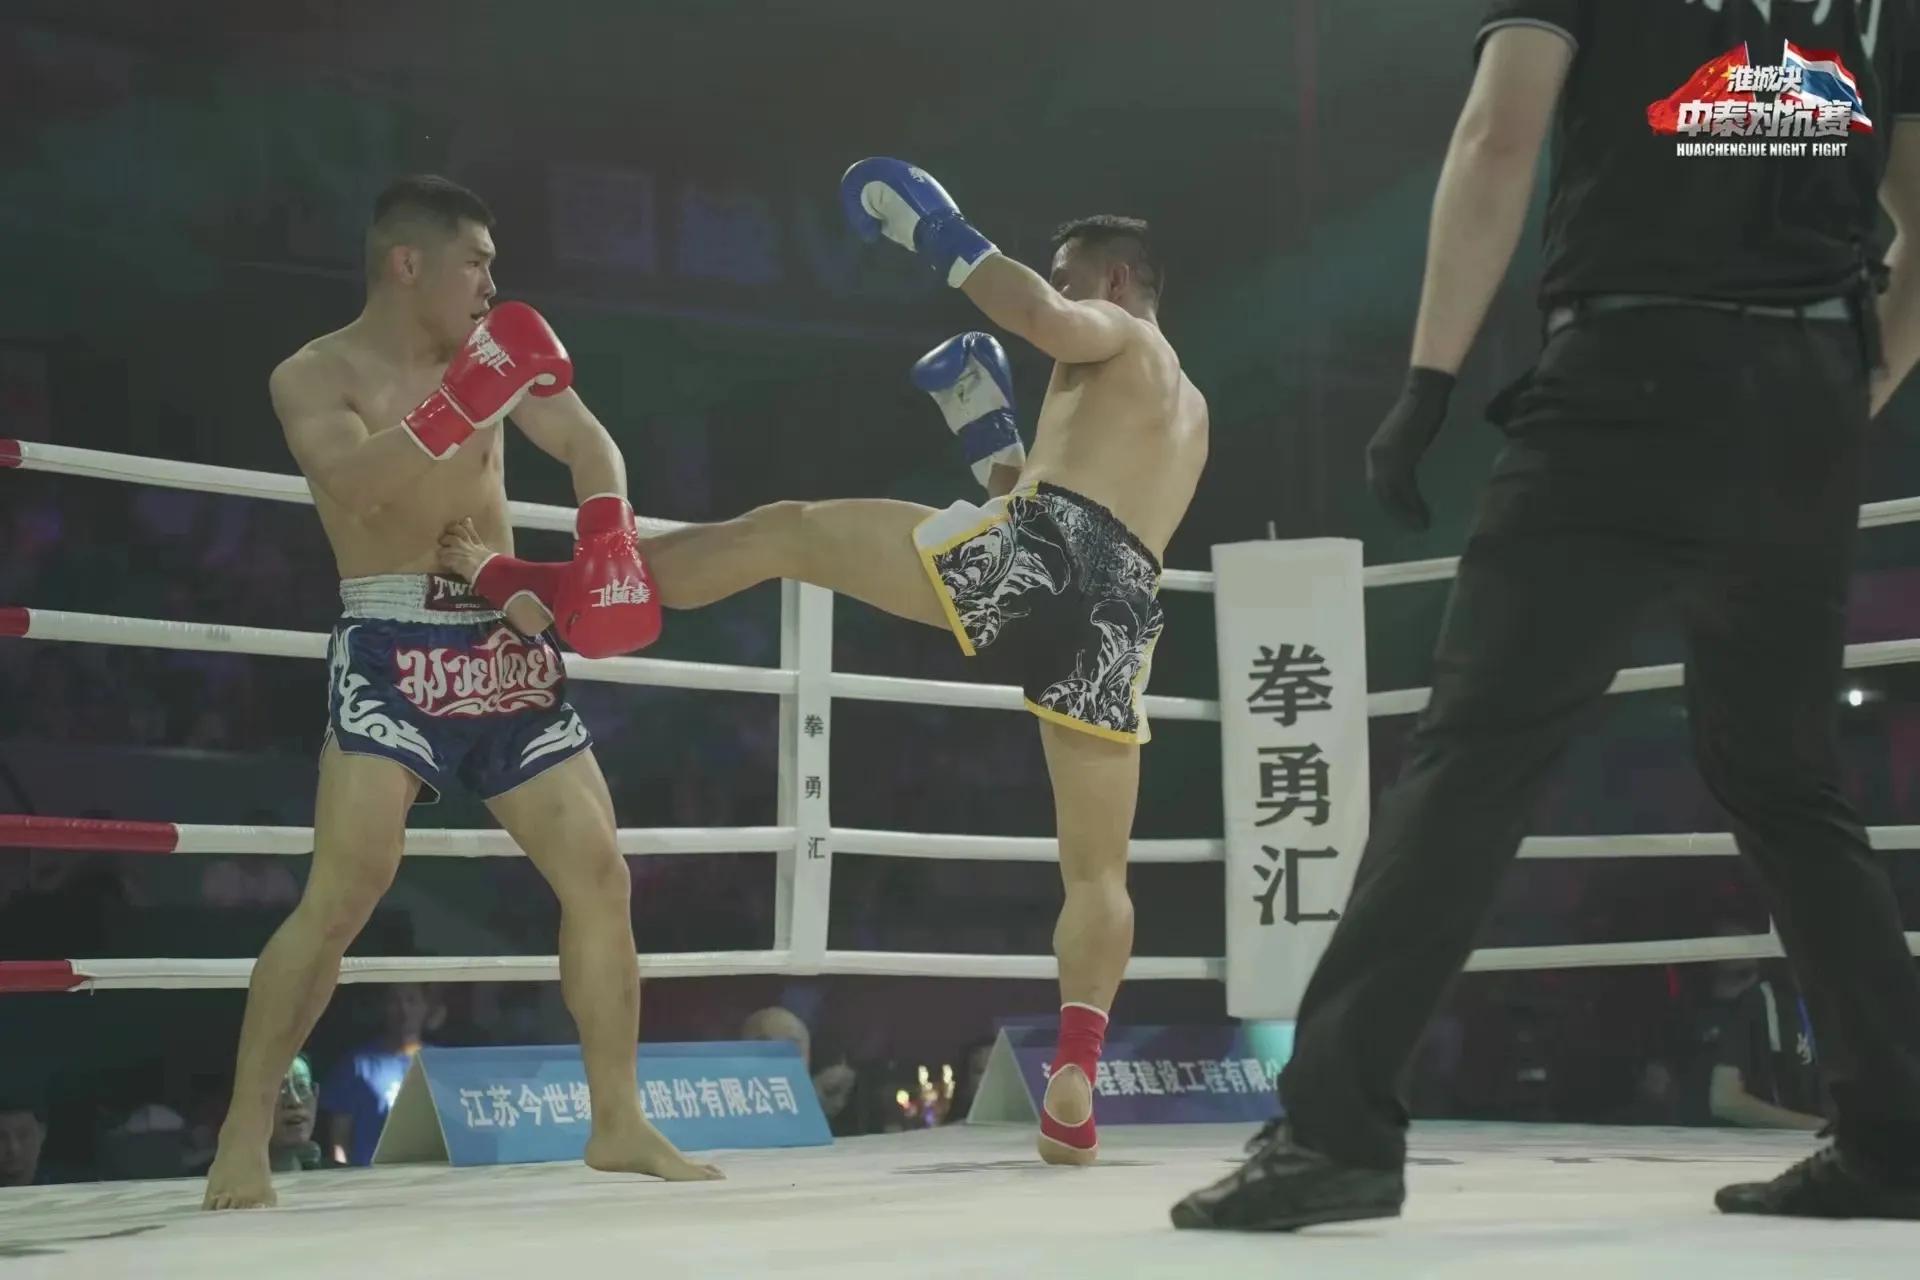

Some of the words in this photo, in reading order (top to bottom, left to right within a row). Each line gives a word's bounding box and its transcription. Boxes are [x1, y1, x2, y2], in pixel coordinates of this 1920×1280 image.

[804, 713, 826, 859] 拳勇汇
[1246, 643, 1341, 925] 拳勇汇
[460, 1076, 799, 1128] 江苏今世缘股份有限公司
